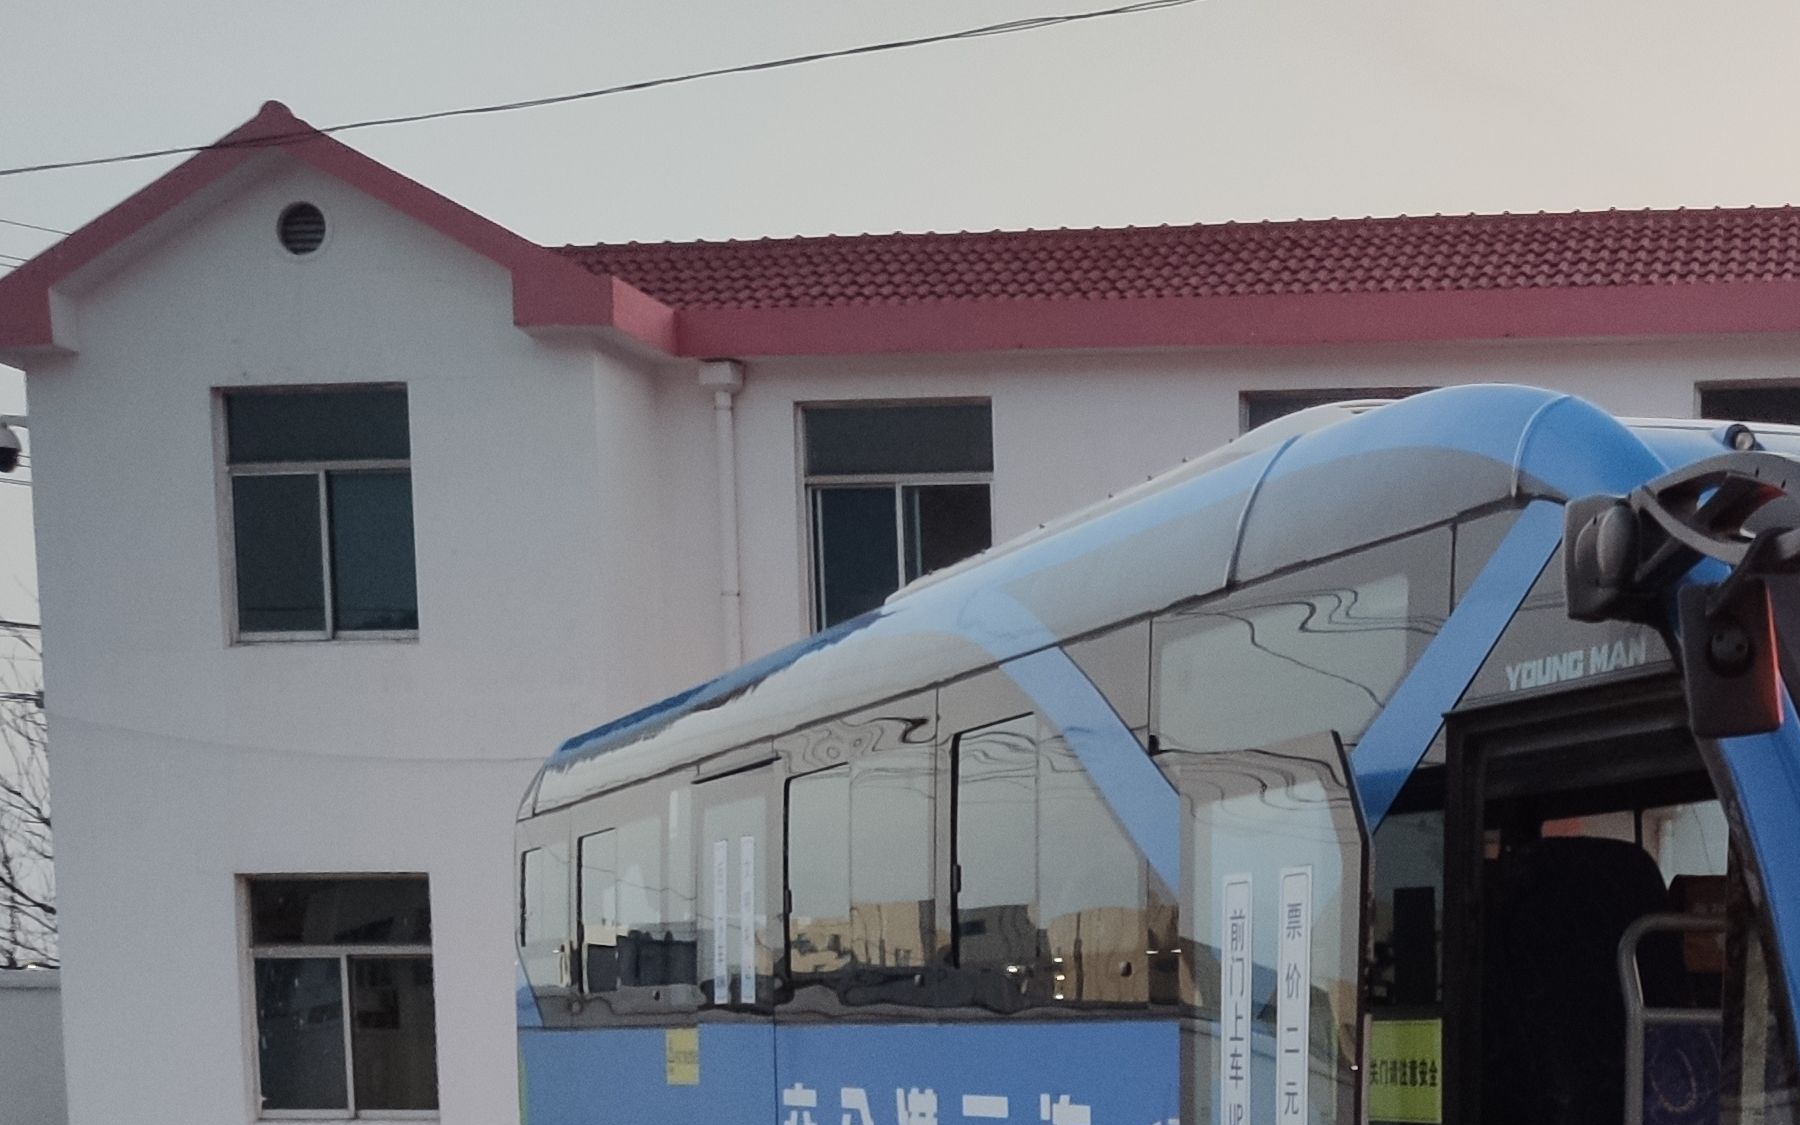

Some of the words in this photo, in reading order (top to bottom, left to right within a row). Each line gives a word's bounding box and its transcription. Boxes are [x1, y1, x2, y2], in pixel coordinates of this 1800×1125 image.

[1505, 650, 1585, 691] YOUNG
[1590, 636, 1647, 675] MAN
[1228, 908, 1246, 1089] 前门上车
[1284, 903, 1304, 1116] 票价二元
